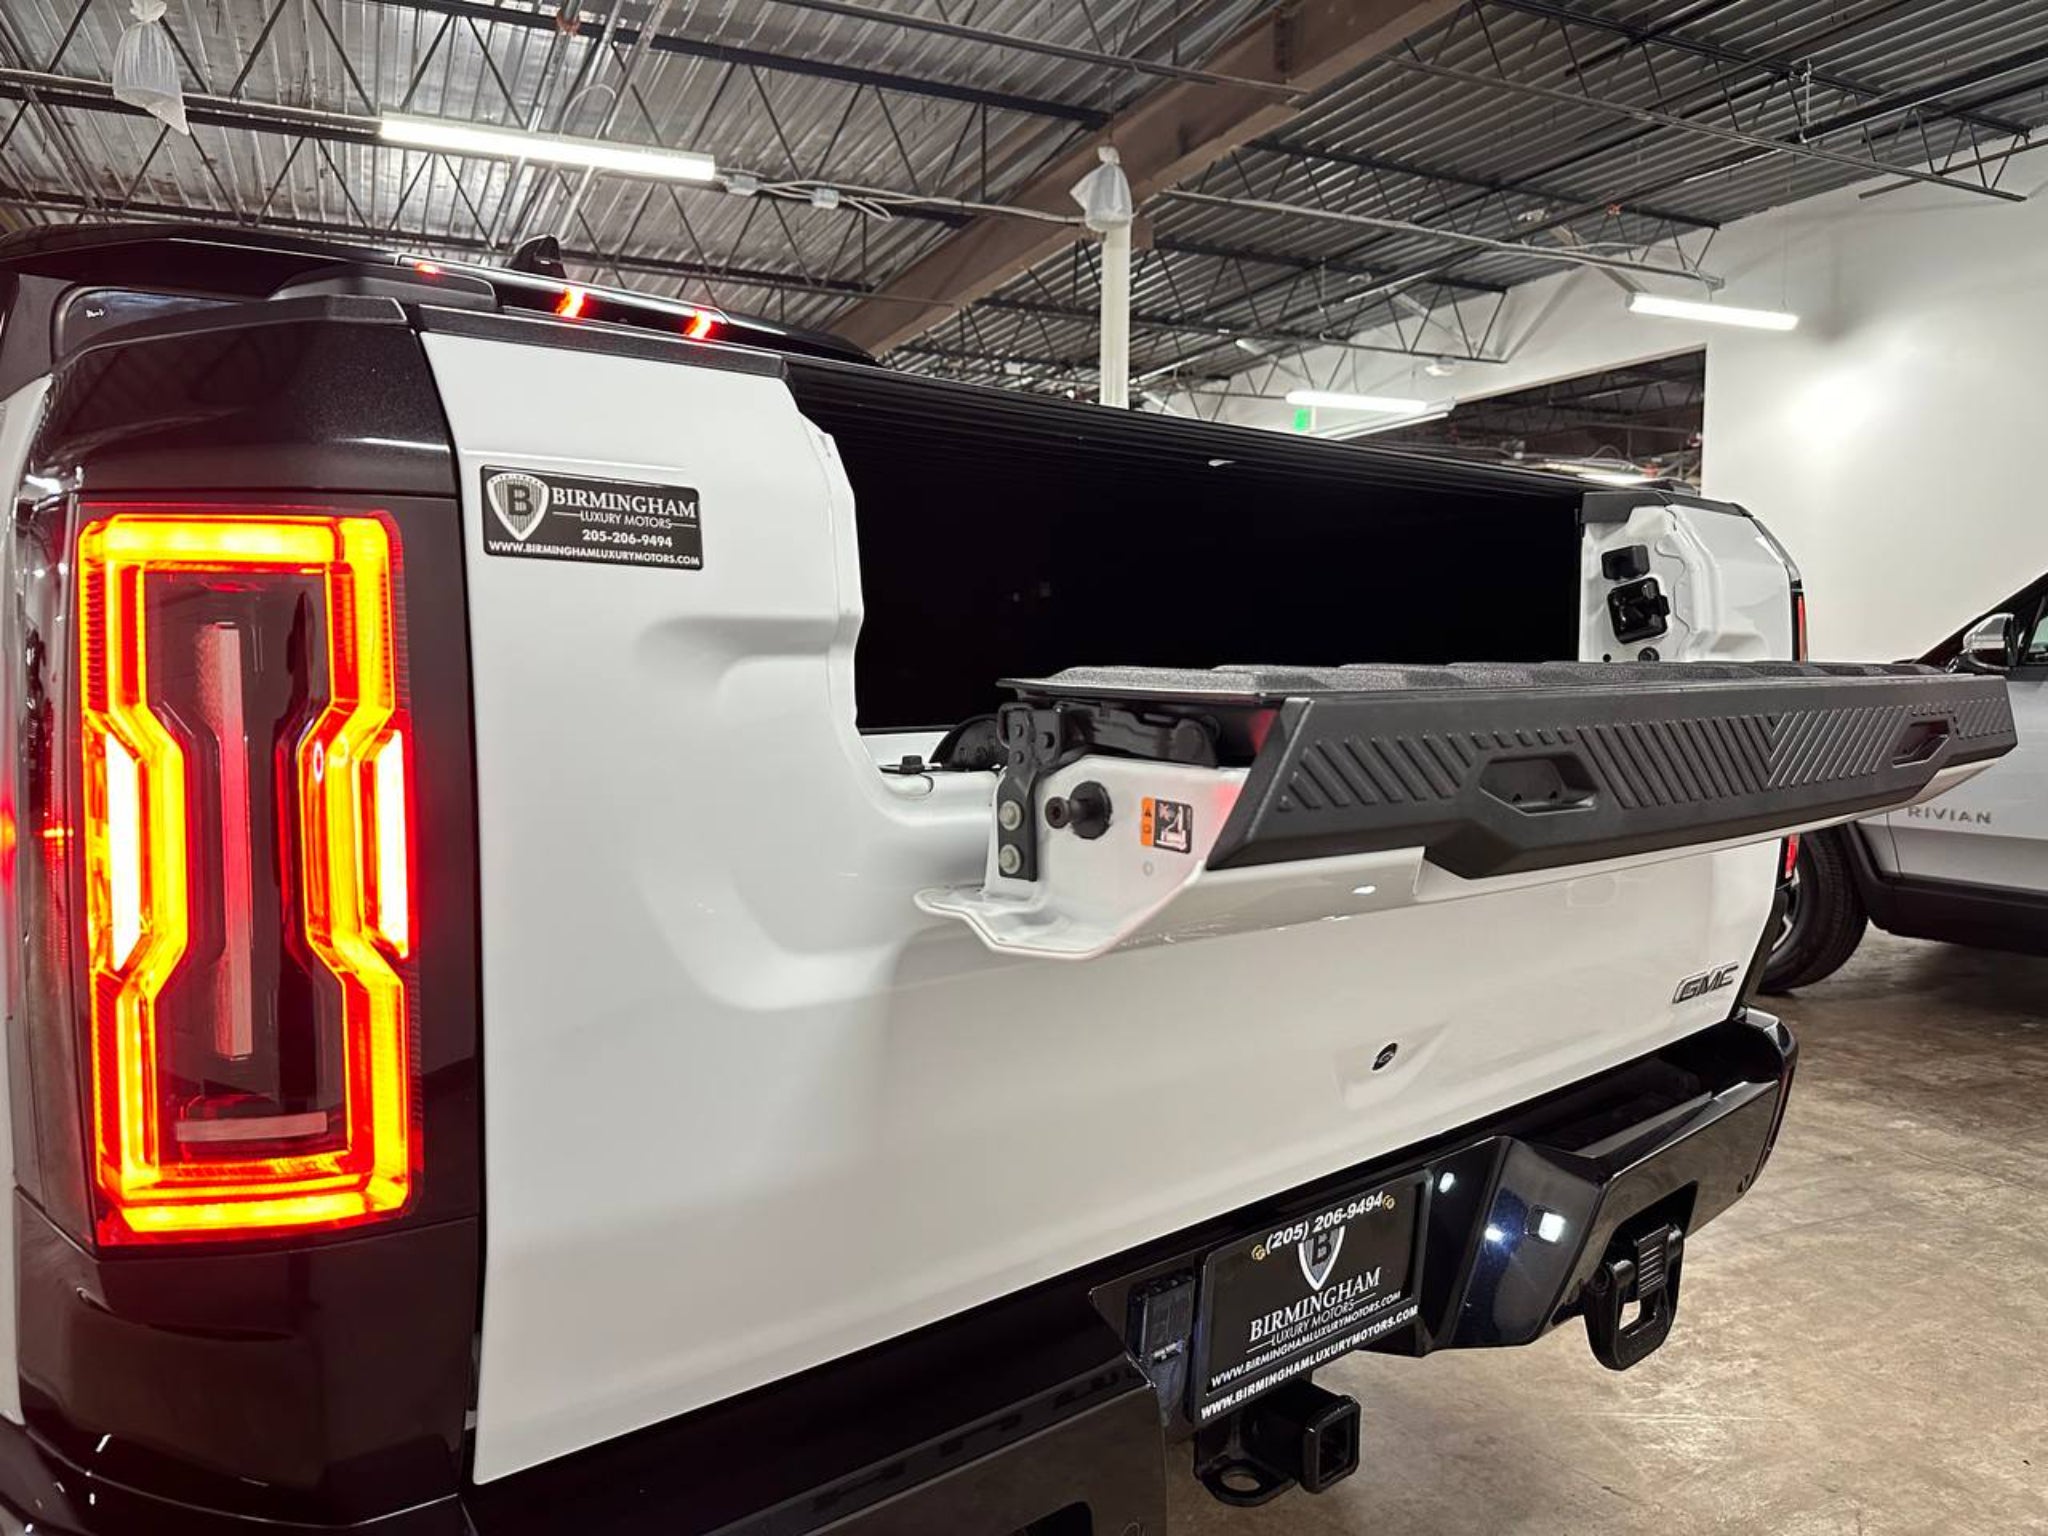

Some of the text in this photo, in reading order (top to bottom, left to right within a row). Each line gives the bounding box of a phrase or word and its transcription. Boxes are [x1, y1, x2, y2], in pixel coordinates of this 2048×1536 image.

[552, 487, 696, 518] BIRMINGHAM
[580, 511, 672, 530] LUXURY MOTORS
[488, 541, 700, 566] WWW.BIRMINGHAMLUXURYMOTORS.COM
[582, 529, 673, 548] 205-206-9494
[1908, 806, 1991, 824] RIVIAN
[1672, 965, 1739, 1004] GMC
[1265, 1191, 1384, 1255] (205) 206-9494
[1249, 1266, 1382, 1342] BIRMINGHAM
[1271, 1300, 1355, 1346] LUXURY MOTORS
[1211, 1291, 1401, 1387] WWW.BIRMINGHAMLUXURYMOTORS.COM
[1201, 1305, 1418, 1419] WWW.BIRMINGHAMLUXURYMOTORS.COM
